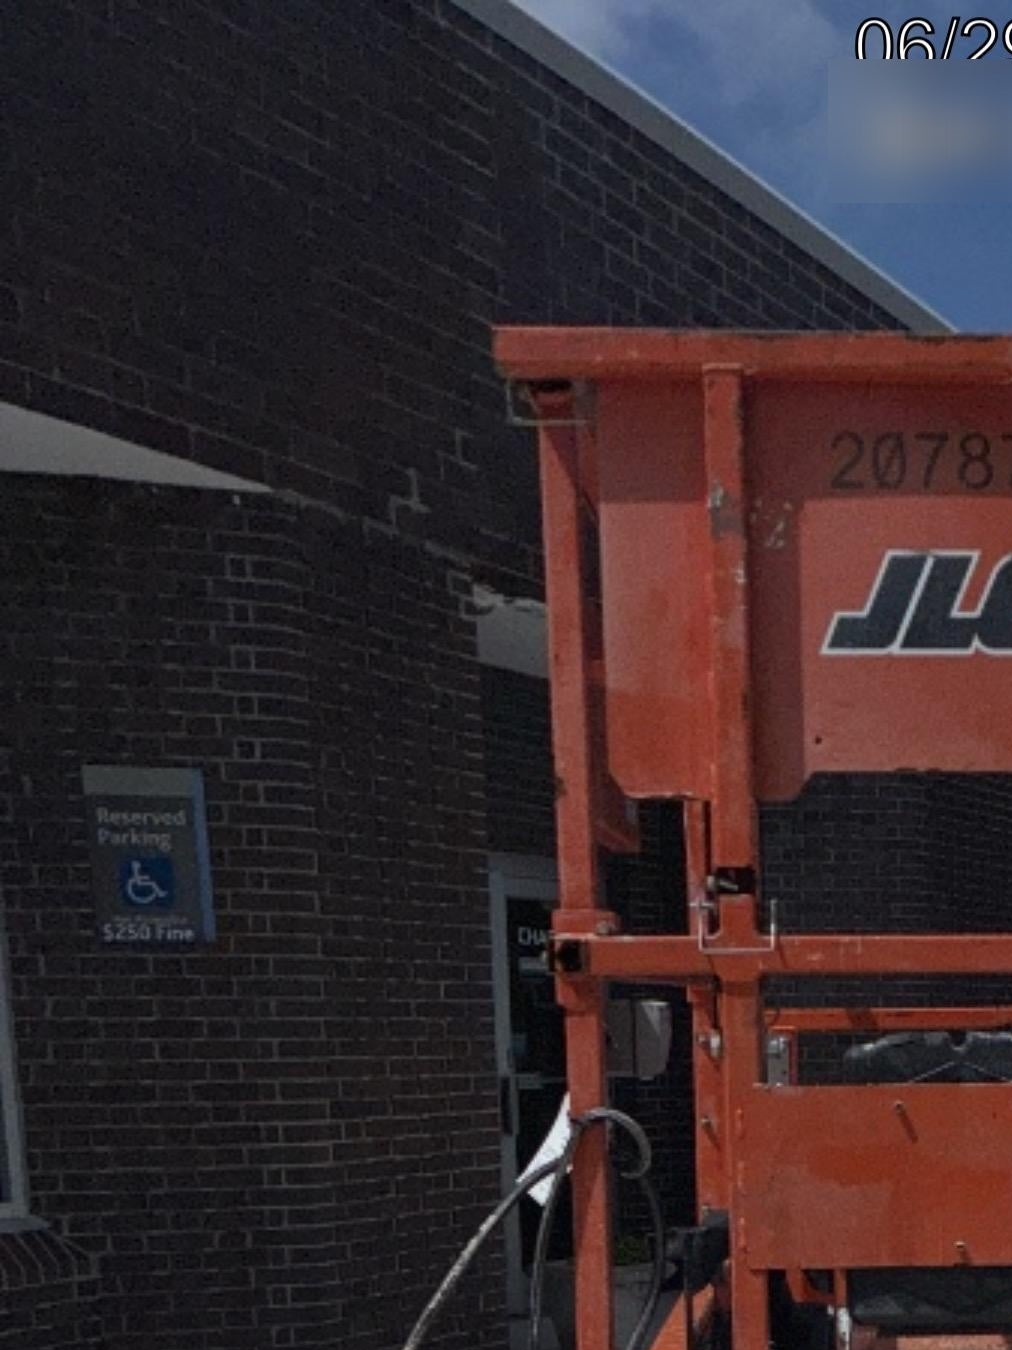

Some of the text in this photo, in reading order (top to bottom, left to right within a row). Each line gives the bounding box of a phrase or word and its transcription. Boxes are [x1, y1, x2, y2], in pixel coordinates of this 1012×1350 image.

[97, 807, 186, 826] Reserved
[97, 827, 173, 851] Parking
[103, 923, 195, 942] $250 Fine
